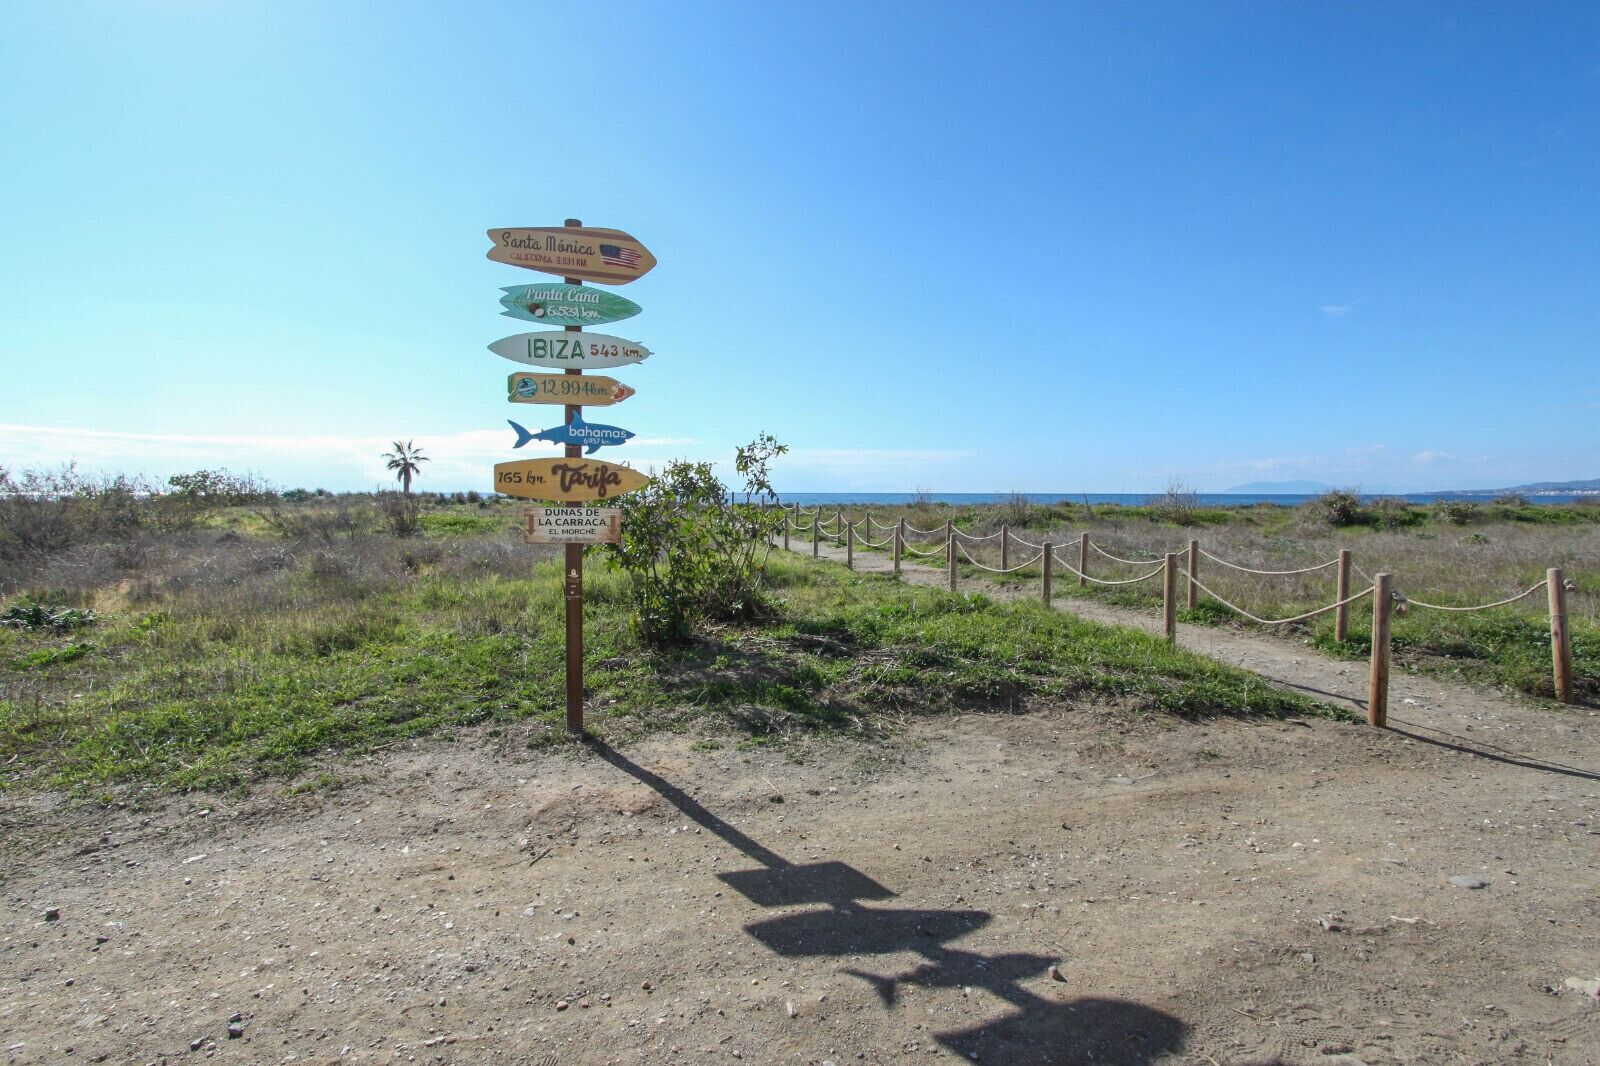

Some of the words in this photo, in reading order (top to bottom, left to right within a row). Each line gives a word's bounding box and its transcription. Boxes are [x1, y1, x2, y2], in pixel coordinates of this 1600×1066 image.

[501, 231, 542, 250] Santa
[545, 235, 595, 256] Mónica
[510, 252, 552, 263] CALIFORNIA
[576, 259, 587, 267] KM
[526, 288, 563, 301] Punta
[567, 289, 600, 304] Cana
[527, 338, 585, 360] IBIZA
[590, 344, 619, 357] 543
[569, 424, 627, 439] bahamas
[498, 471, 523, 484] 165
[526, 470, 547, 486] km.
[551, 463, 622, 498] Tarifa
[545, 508, 583, 517] DUNAS
[586, 508, 600, 517] DE
[538, 518, 552, 526] LA
[555, 518, 607, 527] CARRACA
